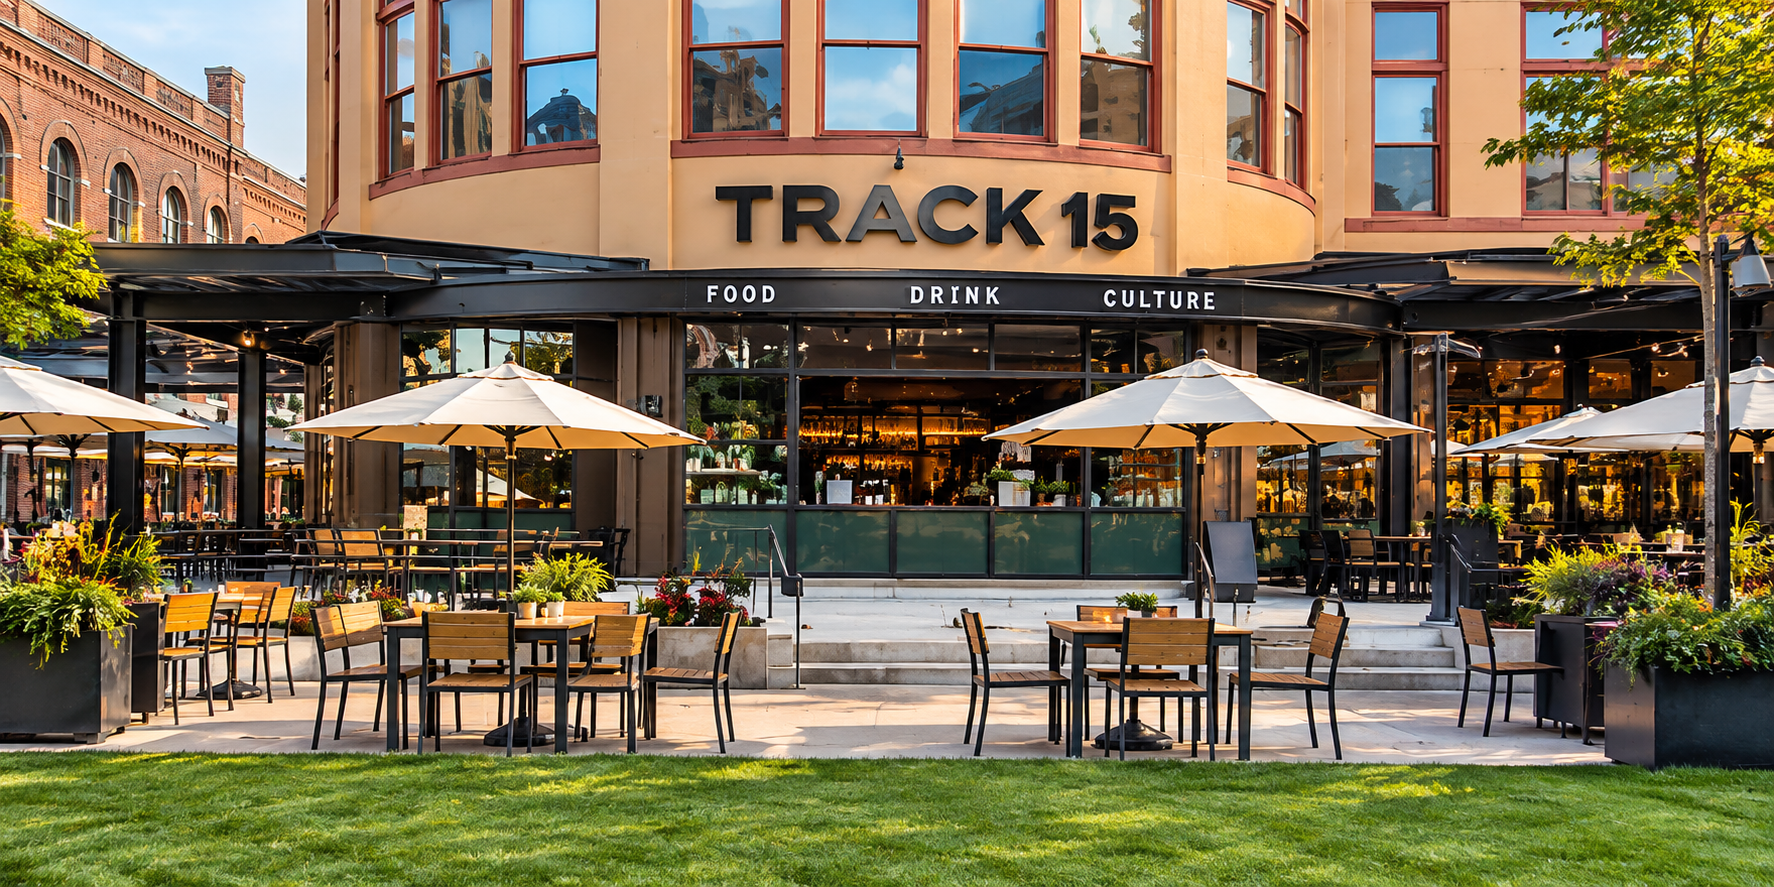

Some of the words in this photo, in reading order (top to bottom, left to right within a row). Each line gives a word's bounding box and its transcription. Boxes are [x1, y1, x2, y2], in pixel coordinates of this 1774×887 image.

[715, 184, 1045, 247] TRACK
[1061, 191, 1139, 252] 15
[706, 284, 776, 304] FOOD
[910, 285, 1000, 305] DRINK
[1103, 289, 1216, 310] CULTURE
